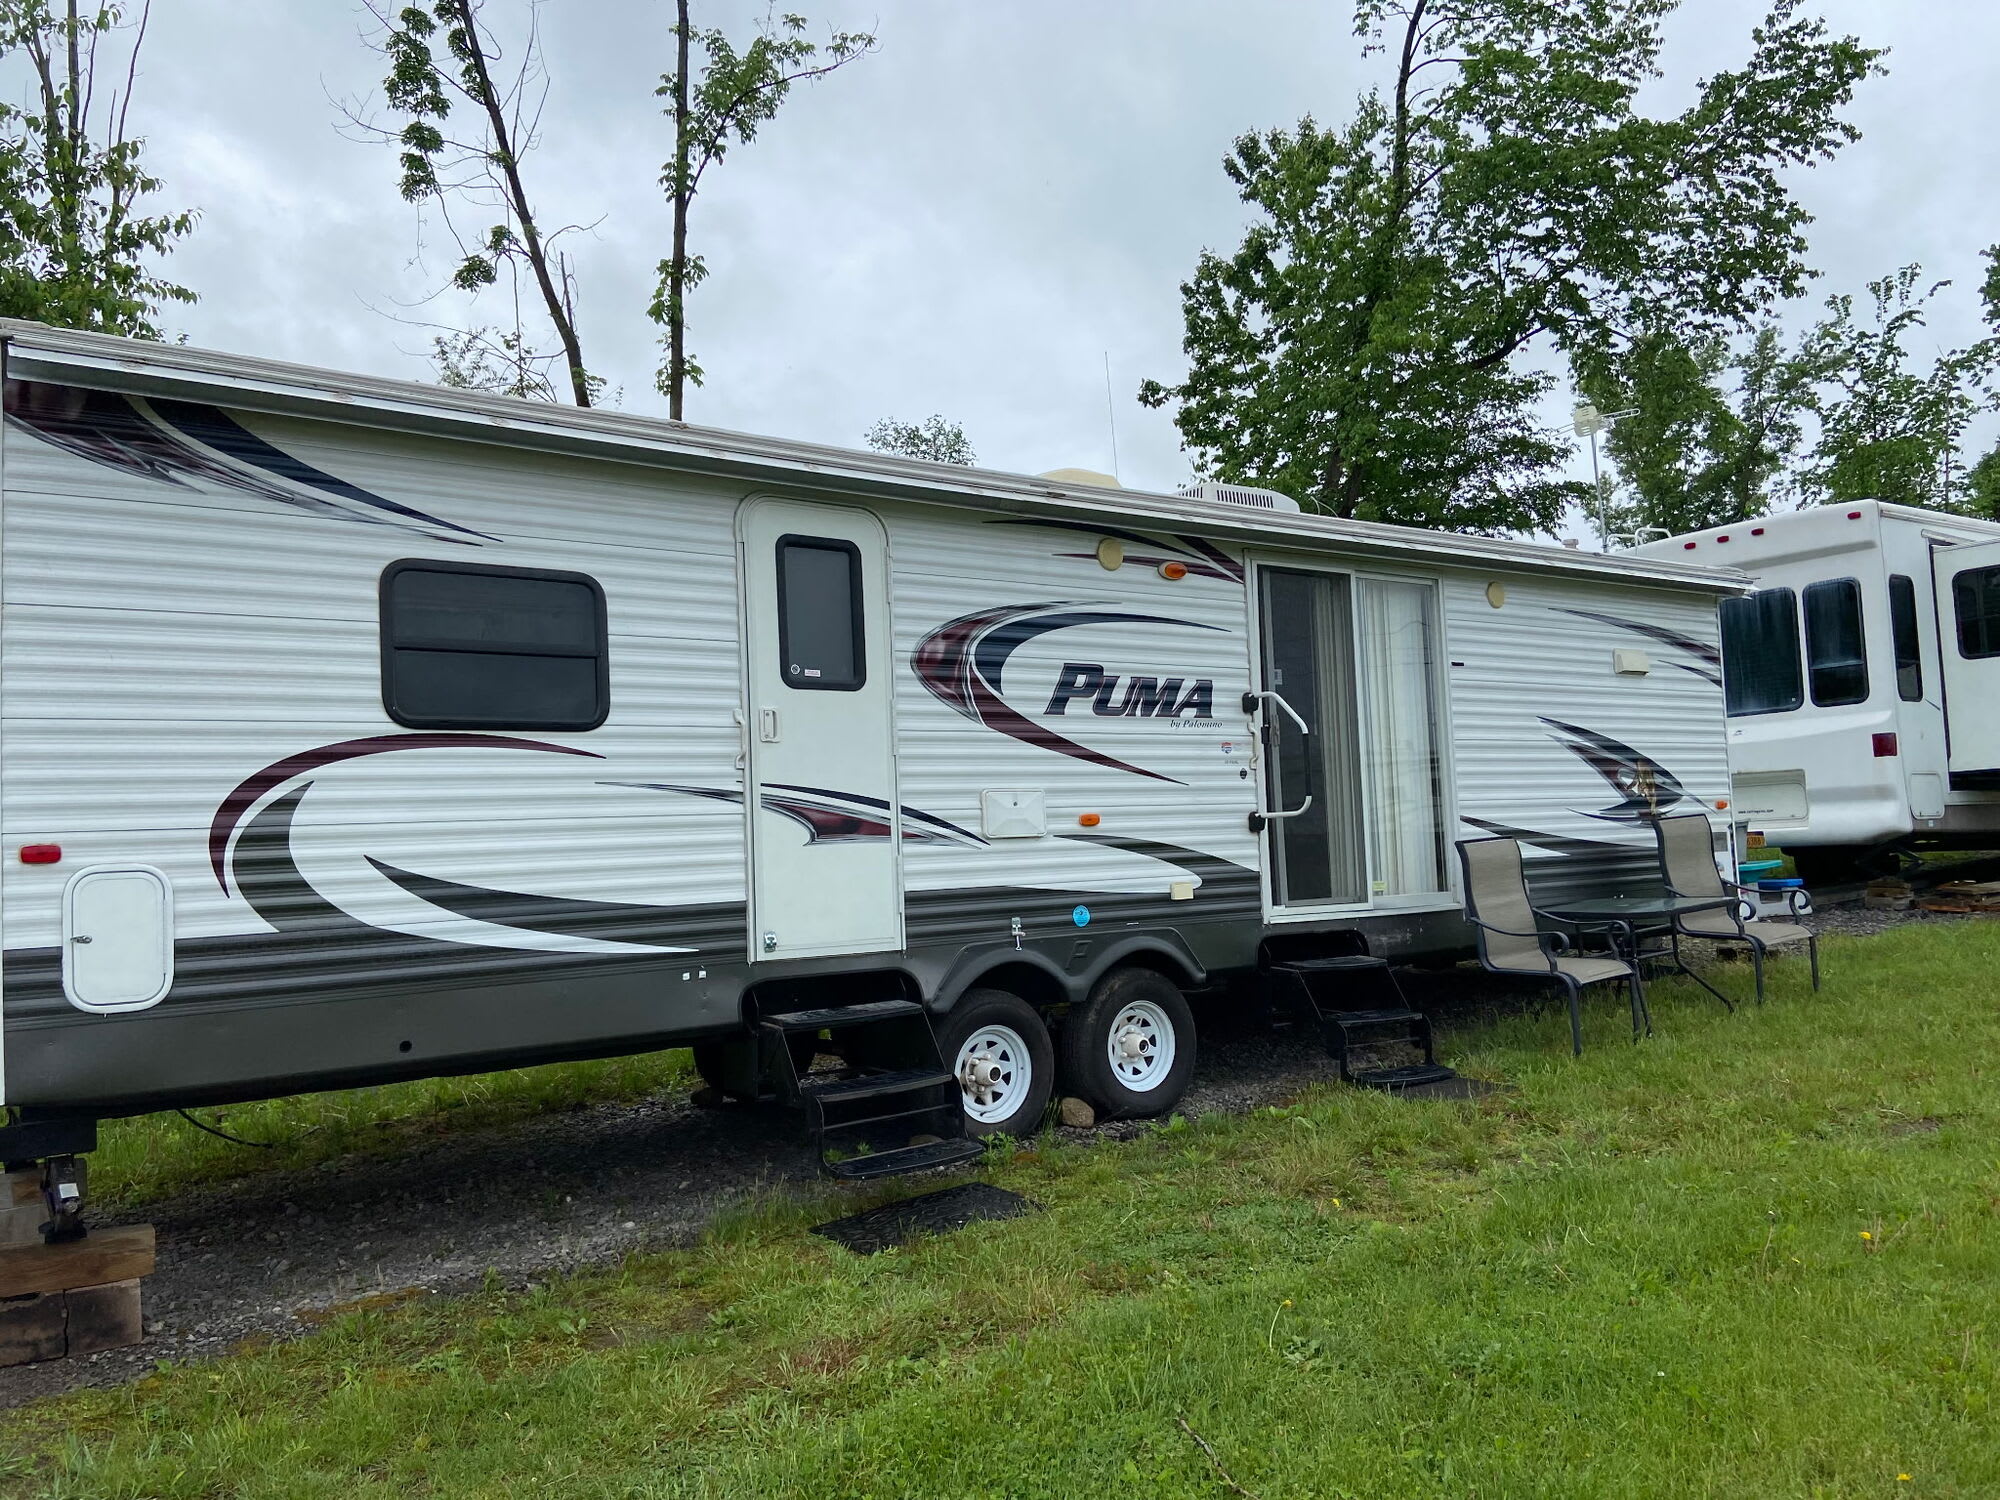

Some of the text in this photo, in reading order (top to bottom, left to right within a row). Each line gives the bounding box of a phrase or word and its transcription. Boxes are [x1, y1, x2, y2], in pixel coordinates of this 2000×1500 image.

[1043, 663, 1213, 718] PUMA
[1170, 719, 1223, 729] by Palomino
